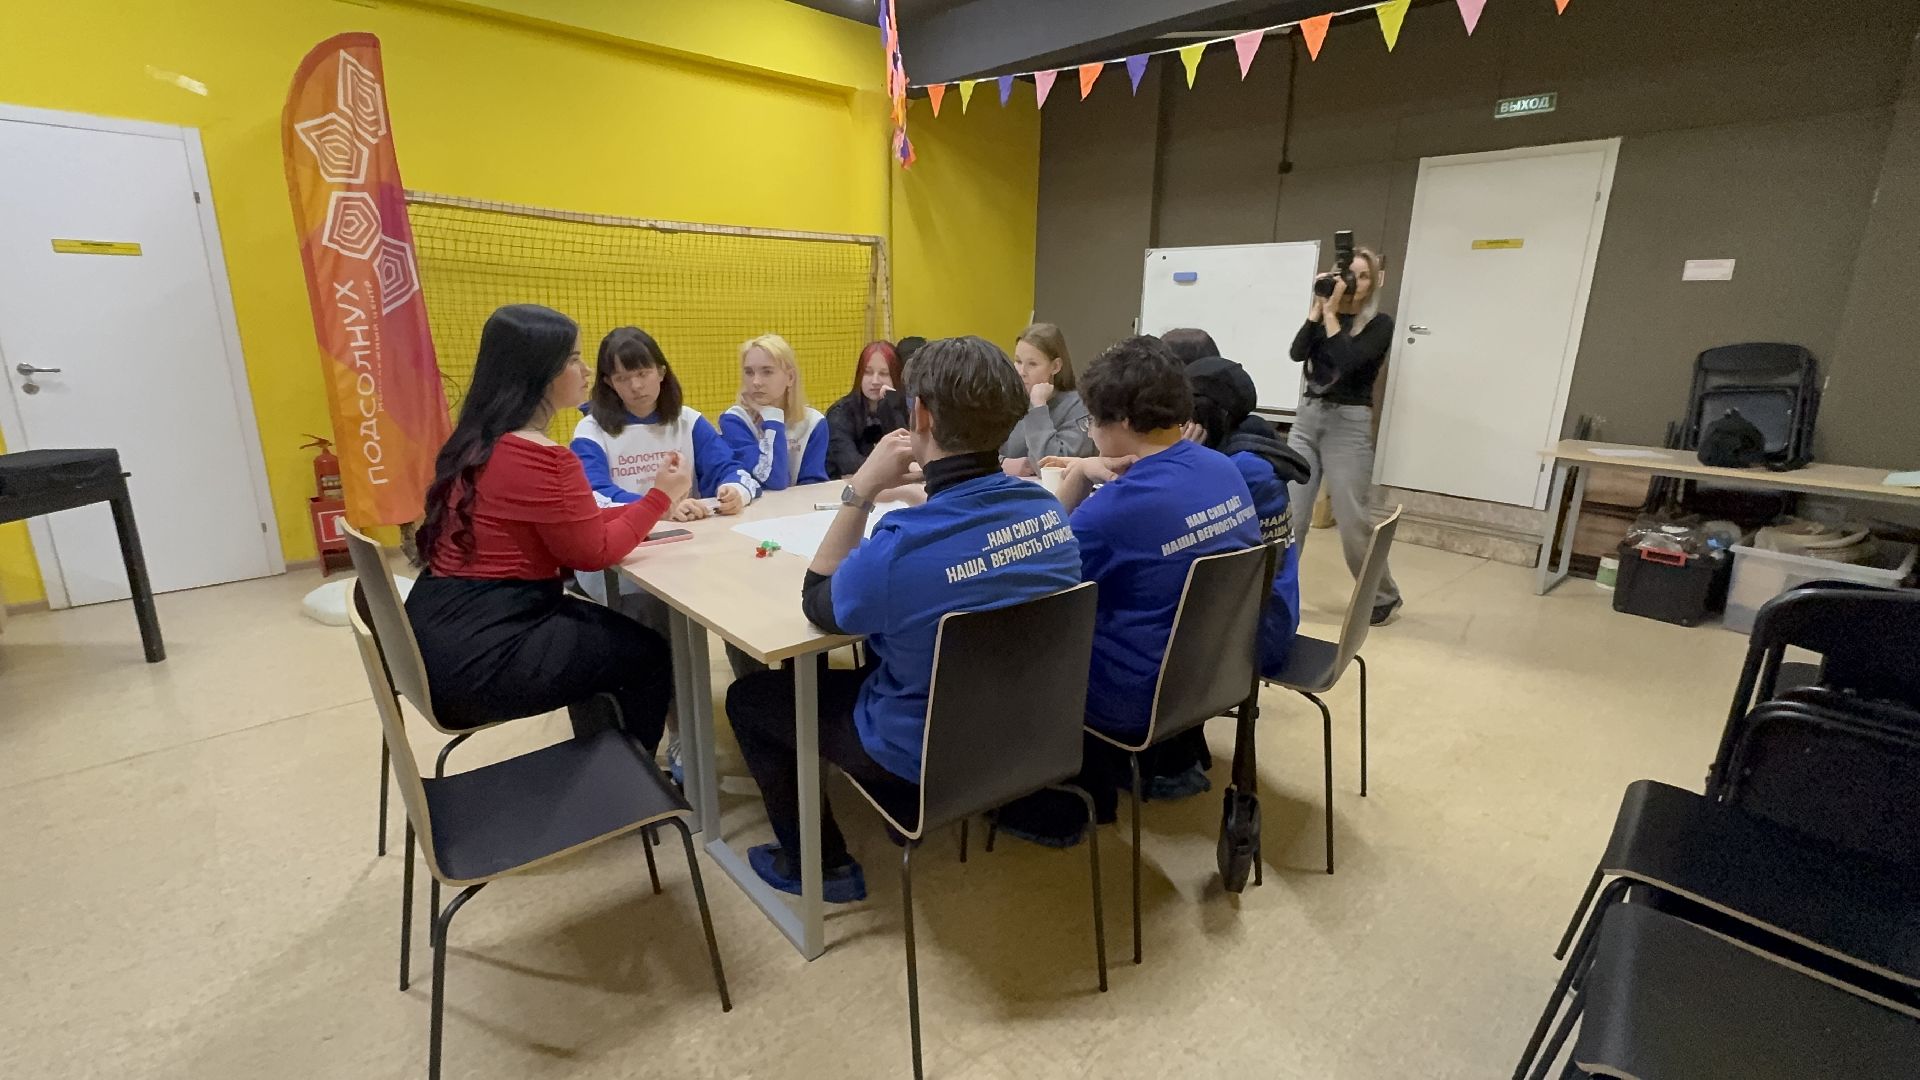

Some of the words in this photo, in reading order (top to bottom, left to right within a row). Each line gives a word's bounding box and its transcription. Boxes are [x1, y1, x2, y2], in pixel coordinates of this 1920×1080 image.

[1500, 97, 1550, 113] ВЫХОД
[333, 279, 389, 485] ПОДСОЛНУХ
[611, 463, 660, 478] Подмос
[1012, 517, 1040, 540] СИЛУ
[1196, 515, 1238, 543] ВЕРНОСТЬ
[945, 557, 988, 584] НАША
[990, 537, 1042, 569] ВЕРНОСТЬ
